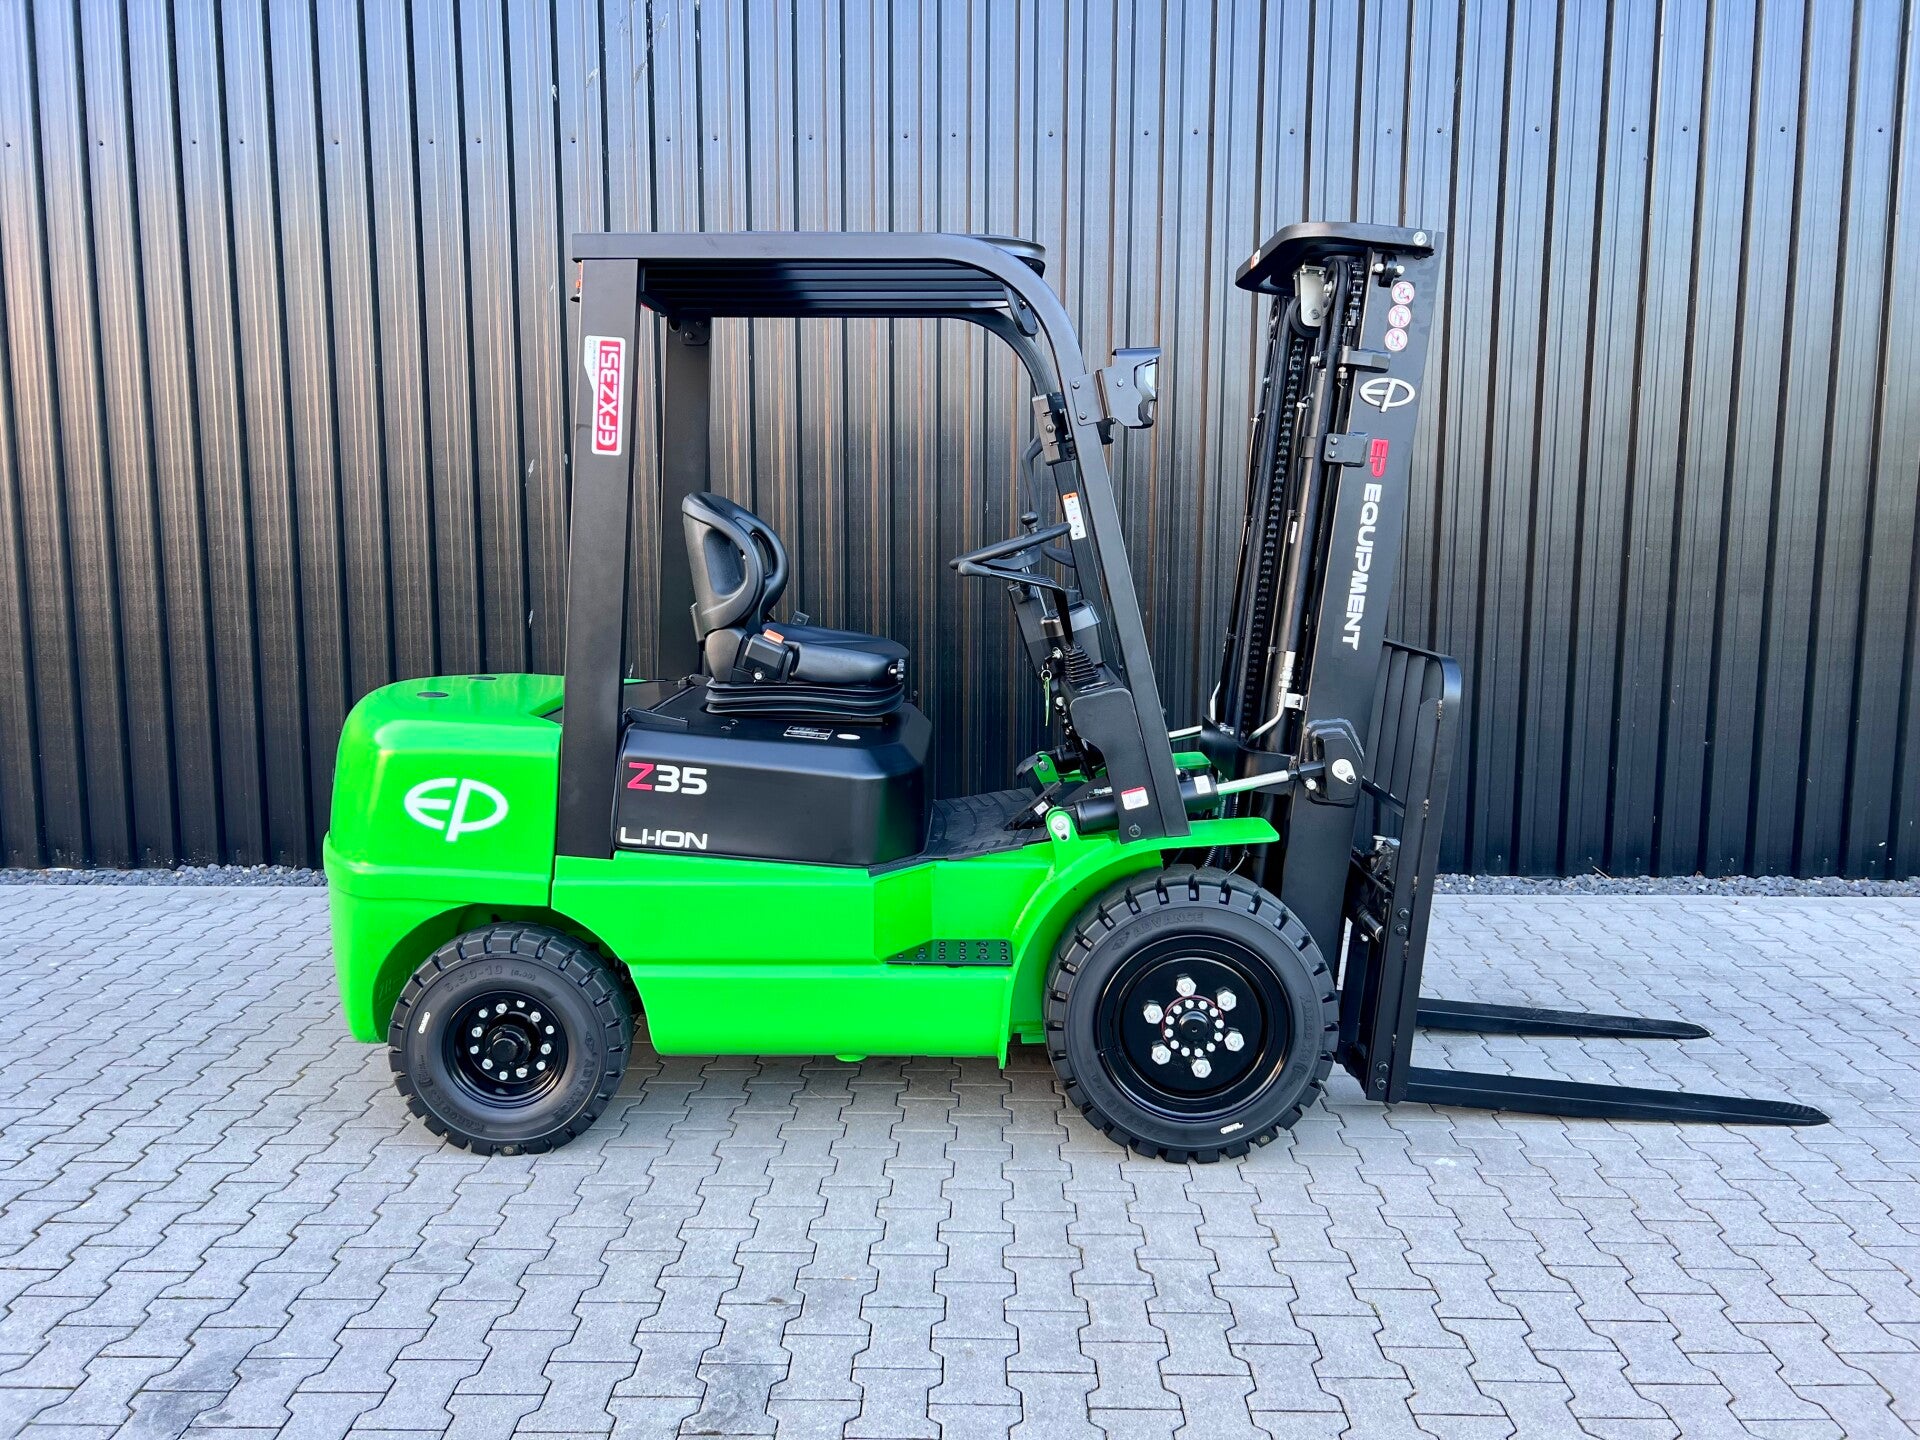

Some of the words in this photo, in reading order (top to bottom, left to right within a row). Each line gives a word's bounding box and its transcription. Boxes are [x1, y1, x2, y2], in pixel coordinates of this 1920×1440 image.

[1369, 438, 1389, 478] EP
[1342, 483, 1383, 651] EQUIPMENT
[626, 761, 708, 796] Z35
[403, 777, 510, 843] EP
